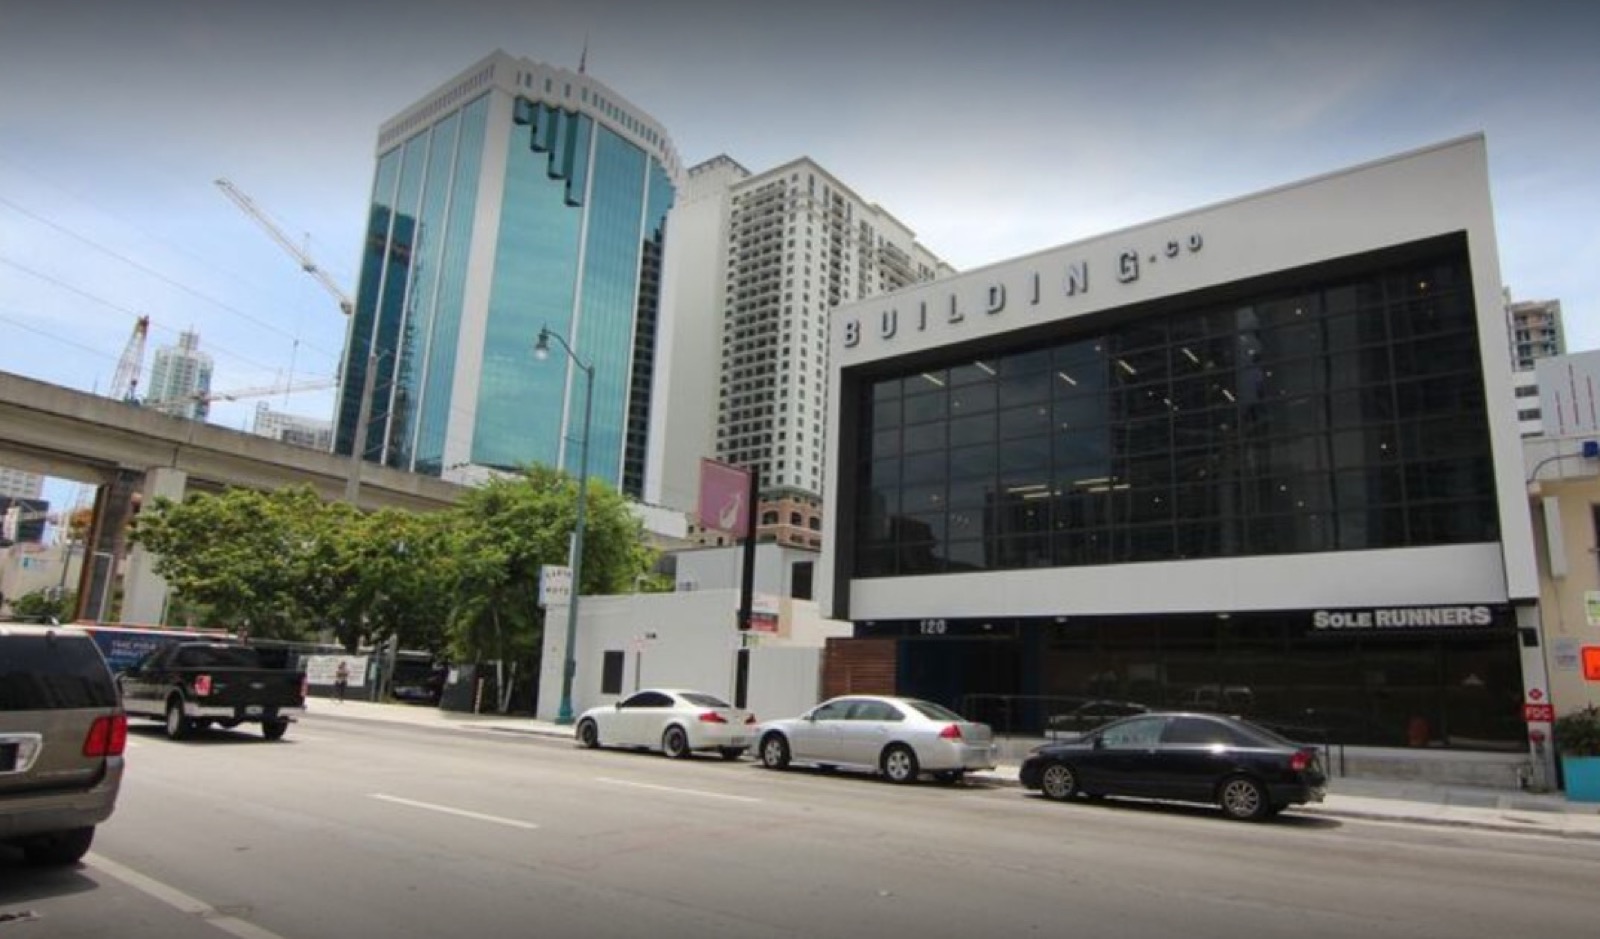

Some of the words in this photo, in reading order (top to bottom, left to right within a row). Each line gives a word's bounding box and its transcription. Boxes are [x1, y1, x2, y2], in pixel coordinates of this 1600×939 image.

[1313, 609, 1373, 628] SOLE
[1375, 605, 1492, 628] RUNNERS
[920, 618, 946, 635] 120
[1526, 706, 1551, 719] FDC
